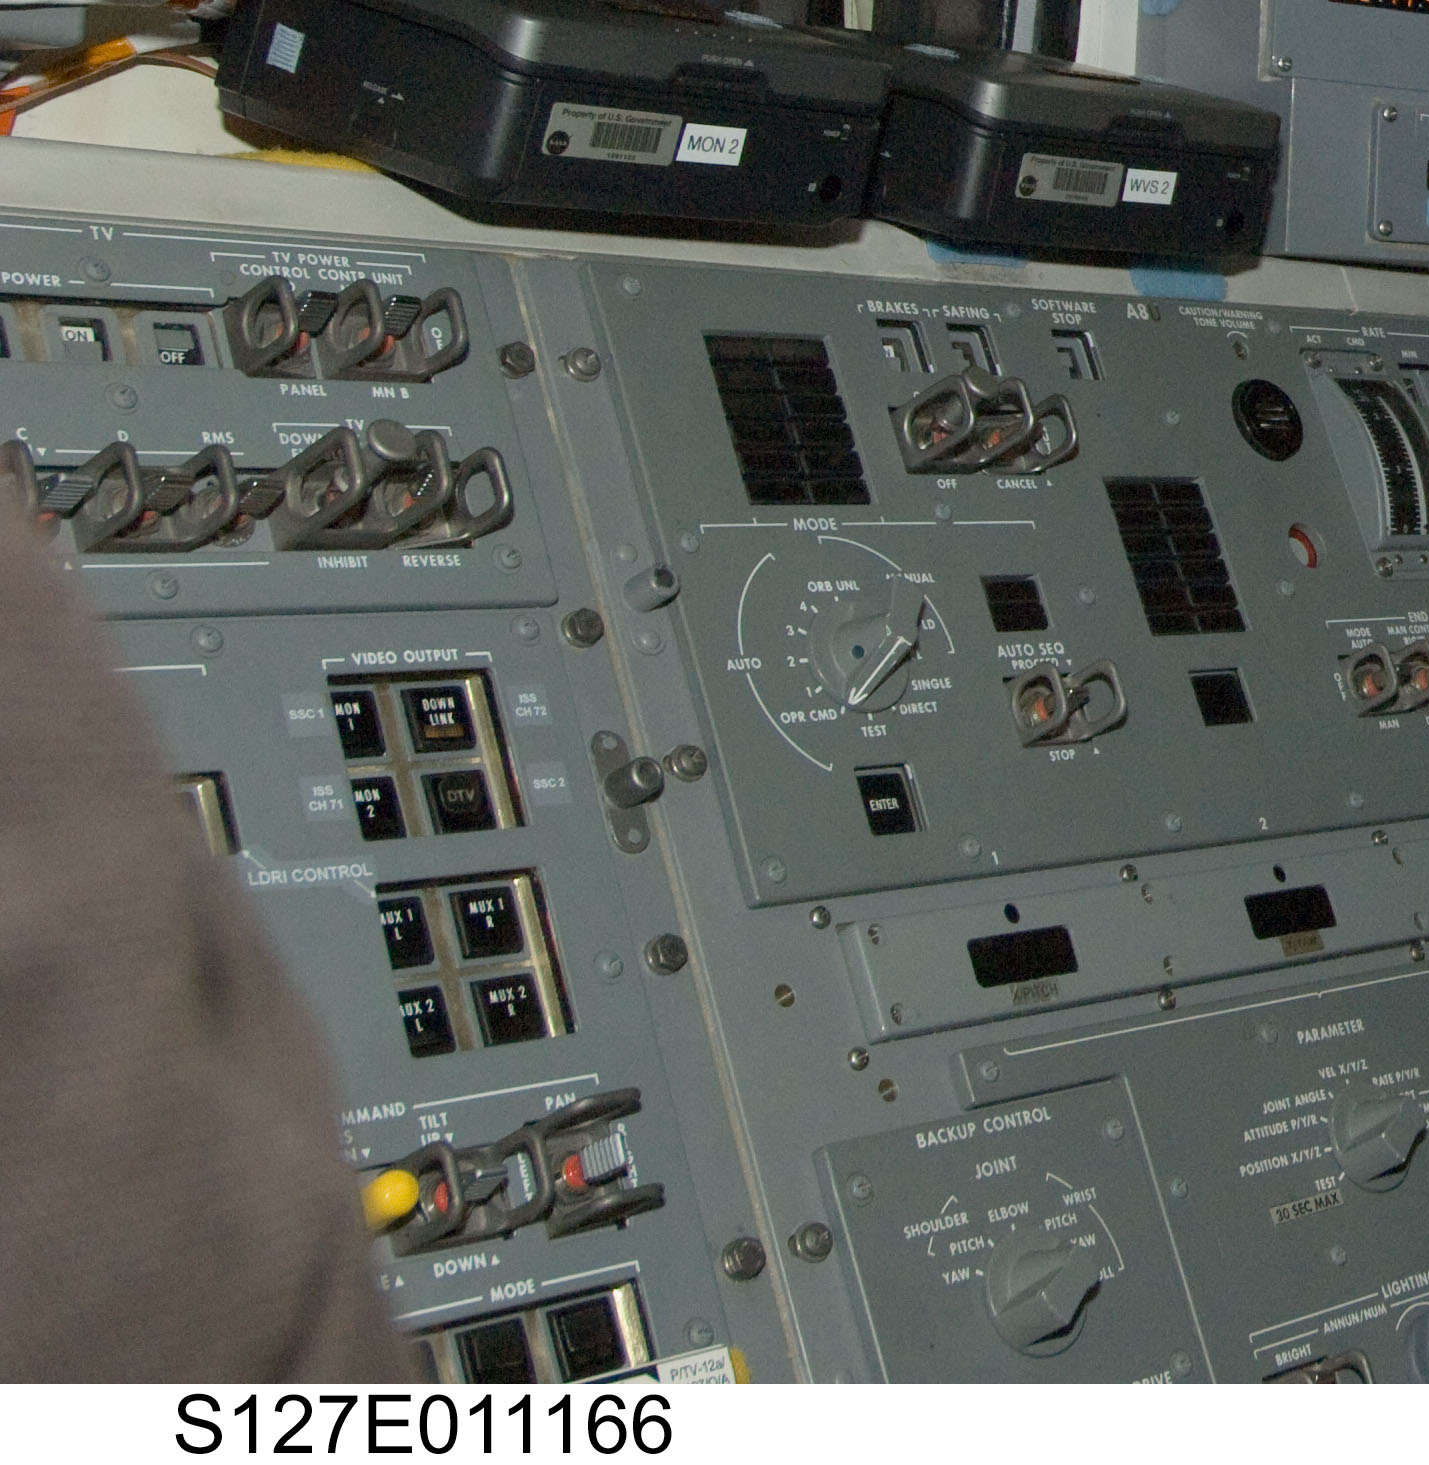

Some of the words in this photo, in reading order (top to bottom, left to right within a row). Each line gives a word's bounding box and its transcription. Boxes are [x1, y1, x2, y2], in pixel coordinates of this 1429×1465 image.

[687, 135, 723, 154] MON
[728, 138, 740, 155] 2
[1130, 178, 1159, 194] WVS
[1161, 181, 1170, 195] 2
[89, 225, 113, 241] TV
[271, 252, 291, 265] TV
[298, 253, 351, 267] POWER
[1, 272, 61, 286] POWER
[371, 272, 403, 286] UNIT
[866, 300, 919, 315] BRAKES
[943, 305, 990, 320] SAFING
[1031, 299, 1096, 314] SOFTWARE
[1179, 306, 1263, 321] CAUTION/WARNING
[1052, 312, 1082, 325] STOP
[1194, 318, 1217, 329] TONE
[1219, 318, 1255, 330] VOLUME
[64, 329, 88, 342] ON
[1361, 327, 1386, 339] RATE
[160, 351, 186, 364] OFF
[279, 383, 327, 397] PANEL
[372, 386, 395, 398] MN
[401, 388, 410, 399] B
[346, 420, 364, 431] TV
[202, 431, 235, 444] RMS
[997, 479, 1038, 490] CANCEL
[793, 518, 838, 532] MODE
[317, 556, 368, 569] INHIBIT
[402, 554, 461, 568] REVERSE
[807, 580, 833, 594] ORB
[1408, 612, 1429, 623] END
[1346, 626, 1371, 638] MODE
[352, 651, 397, 666] VIDEO
[403, 648, 459, 663] OUTPUT
[998, 644, 1036, 658] AUTO
[1039, 642, 1065, 656] SEQ
[727, 658, 762, 671] AUTO
[912, 678, 952, 691] SINGLE
[335, 702, 361, 717] MON
[422, 696, 456, 711] DOWN
[900, 701, 938, 715] DIRECT
[429, 711, 455, 726] LINK
[780, 711, 806, 725] OPR
[810, 709, 838, 723] CMD
[861, 724, 887, 737] TEST
[1049, 748, 1075, 762] STOP
[355, 788, 381, 803] MON
[869, 797, 899, 811] ENTER
[248, 869, 288, 886] LDRI
[292, 863, 373, 883] CONTROL
[469, 900, 495, 915] MUX
[1297, 1019, 1364, 1045] PARAMETER
[1318, 1065, 1336, 1080] VEL
[1338, 1059, 1369, 1075] X/Y/Z
[545, 1092, 576, 1110] PAN
[1263, 1098, 1293, 1116] JOINT
[1295, 1089, 1327, 1107] ANGLE
[419, 1112, 448, 1129] TILT
[916, 1123, 976, 1149] BACKUP
[984, 1107, 1051, 1134] CONTROL
[1244, 1124, 1287, 1142] ATTITUDE
[1290, 1114, 1319, 1131] P/Y/R
[975, 1156, 1017, 1180] JOINT
[1240, 1155, 1289, 1177] POSITION
[1291, 1147, 1322, 1164] X/Y/Z
[1315, 1177, 1337, 1191] TEST
[1062, 1186, 1097, 1207] WRIST
[988, 1200, 1029, 1223] ELBOW
[1276, 1208, 1290, 1223] 30
[1292, 1200, 1313, 1218] SEC
[1315, 1192, 1340, 1211] MAX
[903, 1211, 969, 1239] SHOULDER
[1045, 1212, 1078, 1231] PITCH
[950, 1237, 985, 1256] PITCH
[433, 1257, 488, 1279] DOWN
[942, 1267, 971, 1285] YAW
[490, 1279, 536, 1303] MODE
[1324, 1304, 1388, 1333] ANNUN/NUM
[1274, 1344, 1312, 1367] BRIGHT
